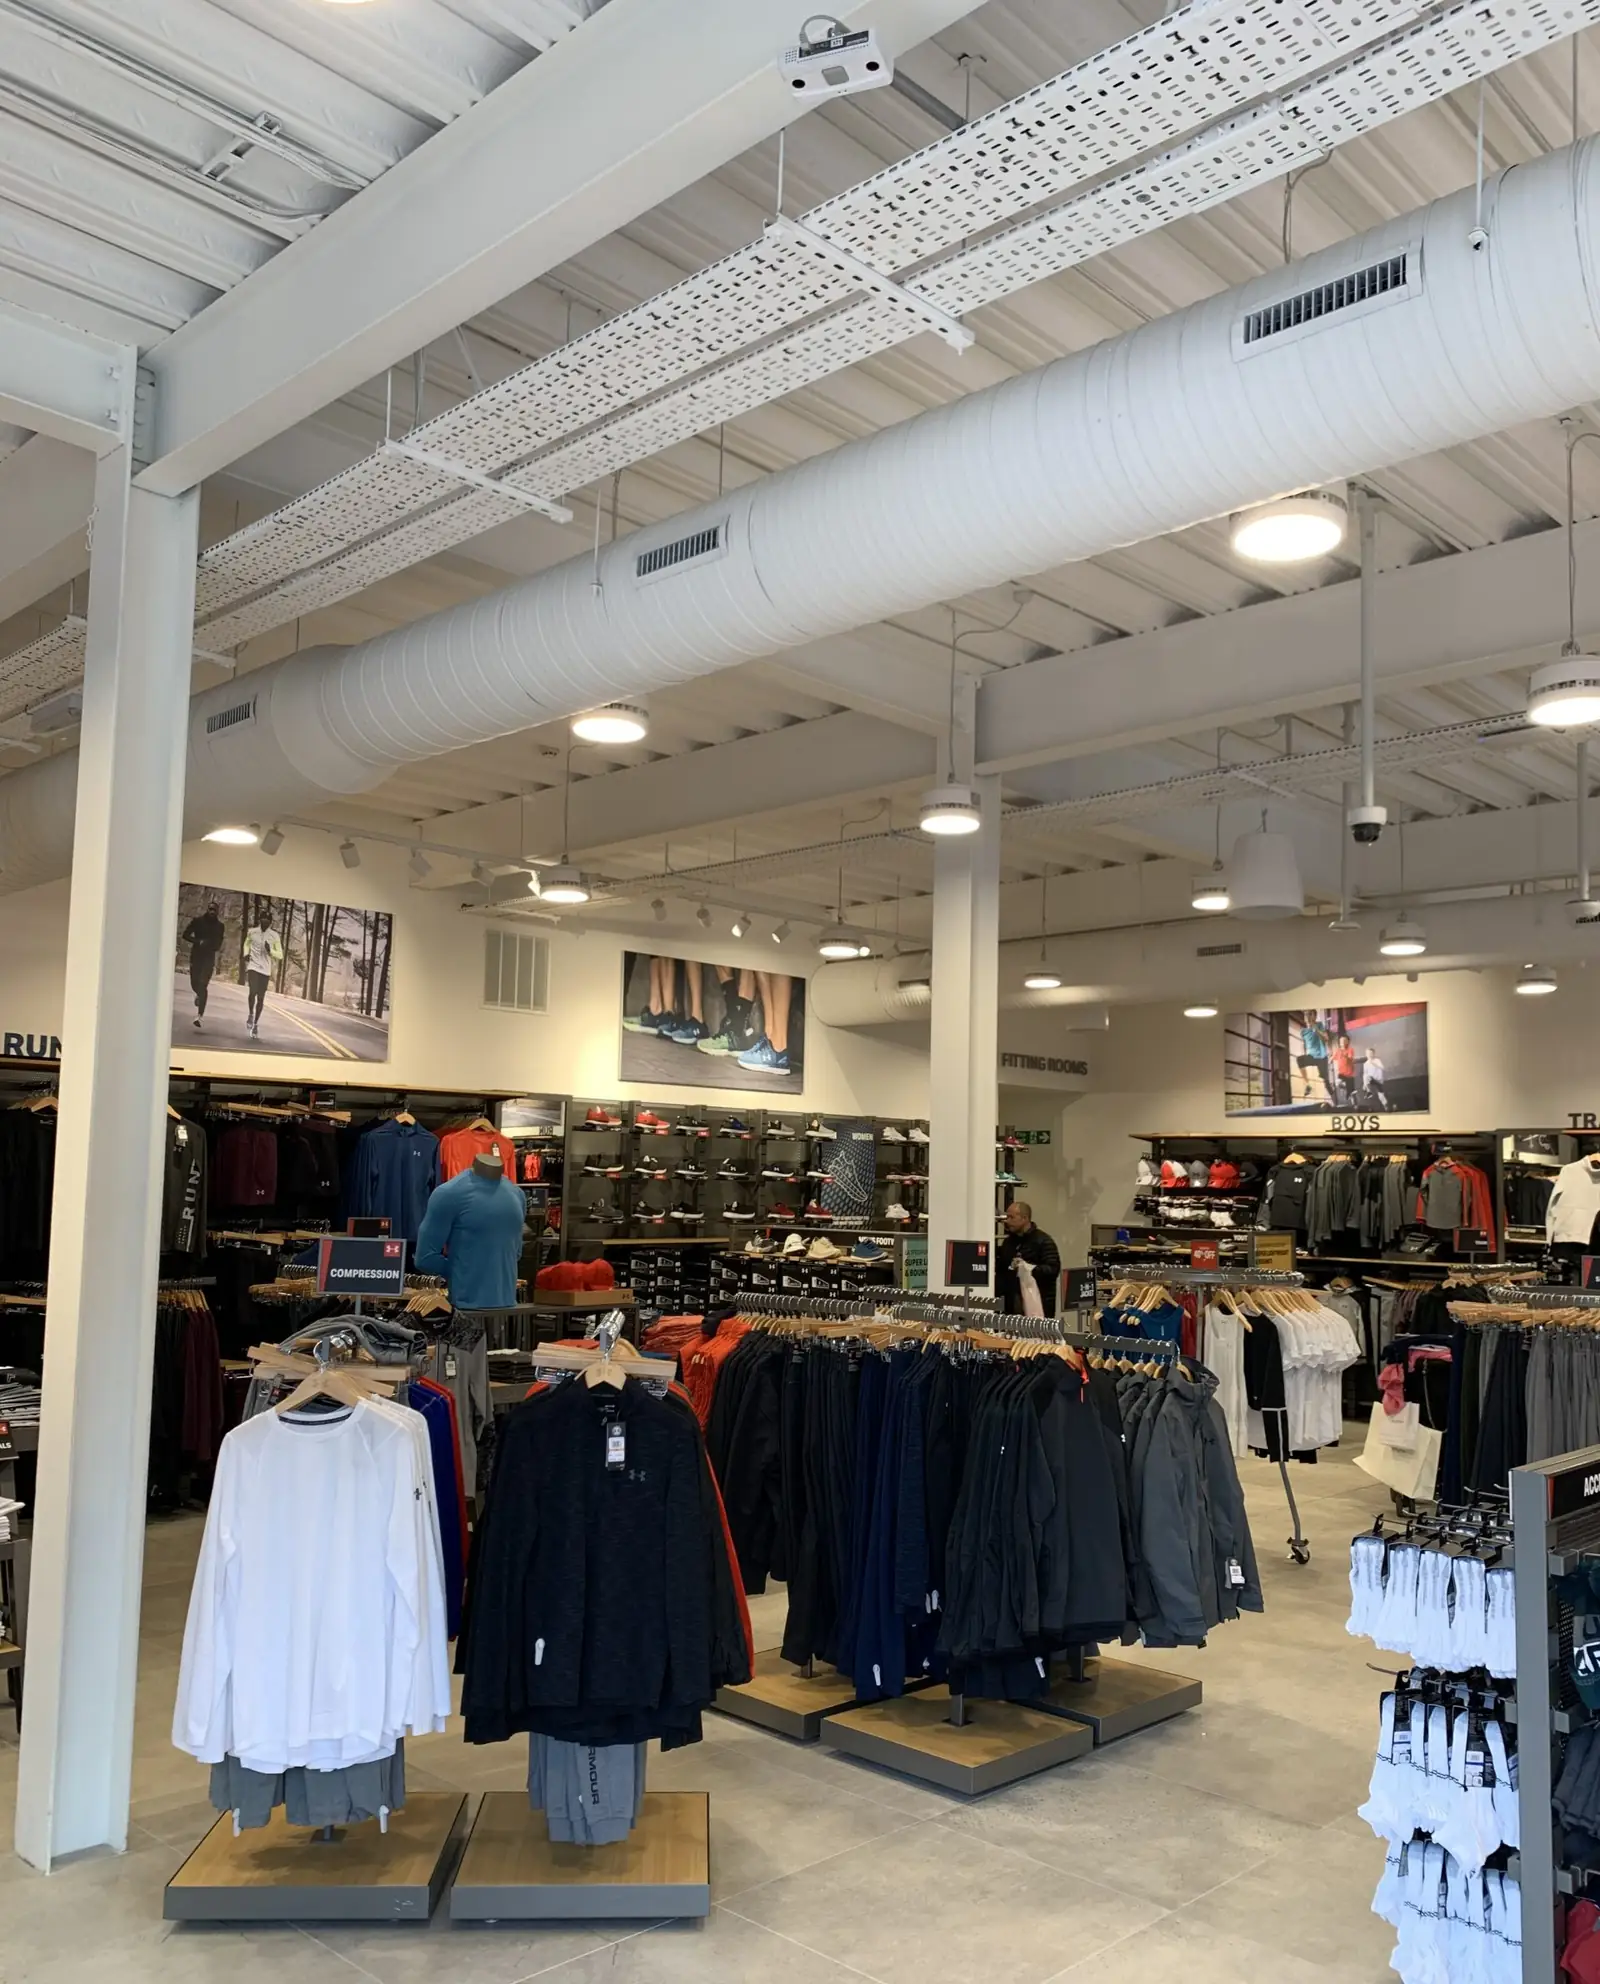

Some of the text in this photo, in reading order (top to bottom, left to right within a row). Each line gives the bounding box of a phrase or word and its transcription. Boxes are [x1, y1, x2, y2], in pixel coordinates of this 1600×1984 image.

[1002, 1052, 1088, 1076] FITTING ROOMS
[1331, 1115, 1380, 1131] BOYS
[1567, 1112, 1600, 1129] TR
[182, 1158, 201, 1220] RUN
[904, 1258, 922, 1267] SUPER
[972, 1263, 987, 1272] TRAIN
[330, 1268, 400, 1280] COMPRESSION
[1583, 1472, 1600, 1498] ACC
